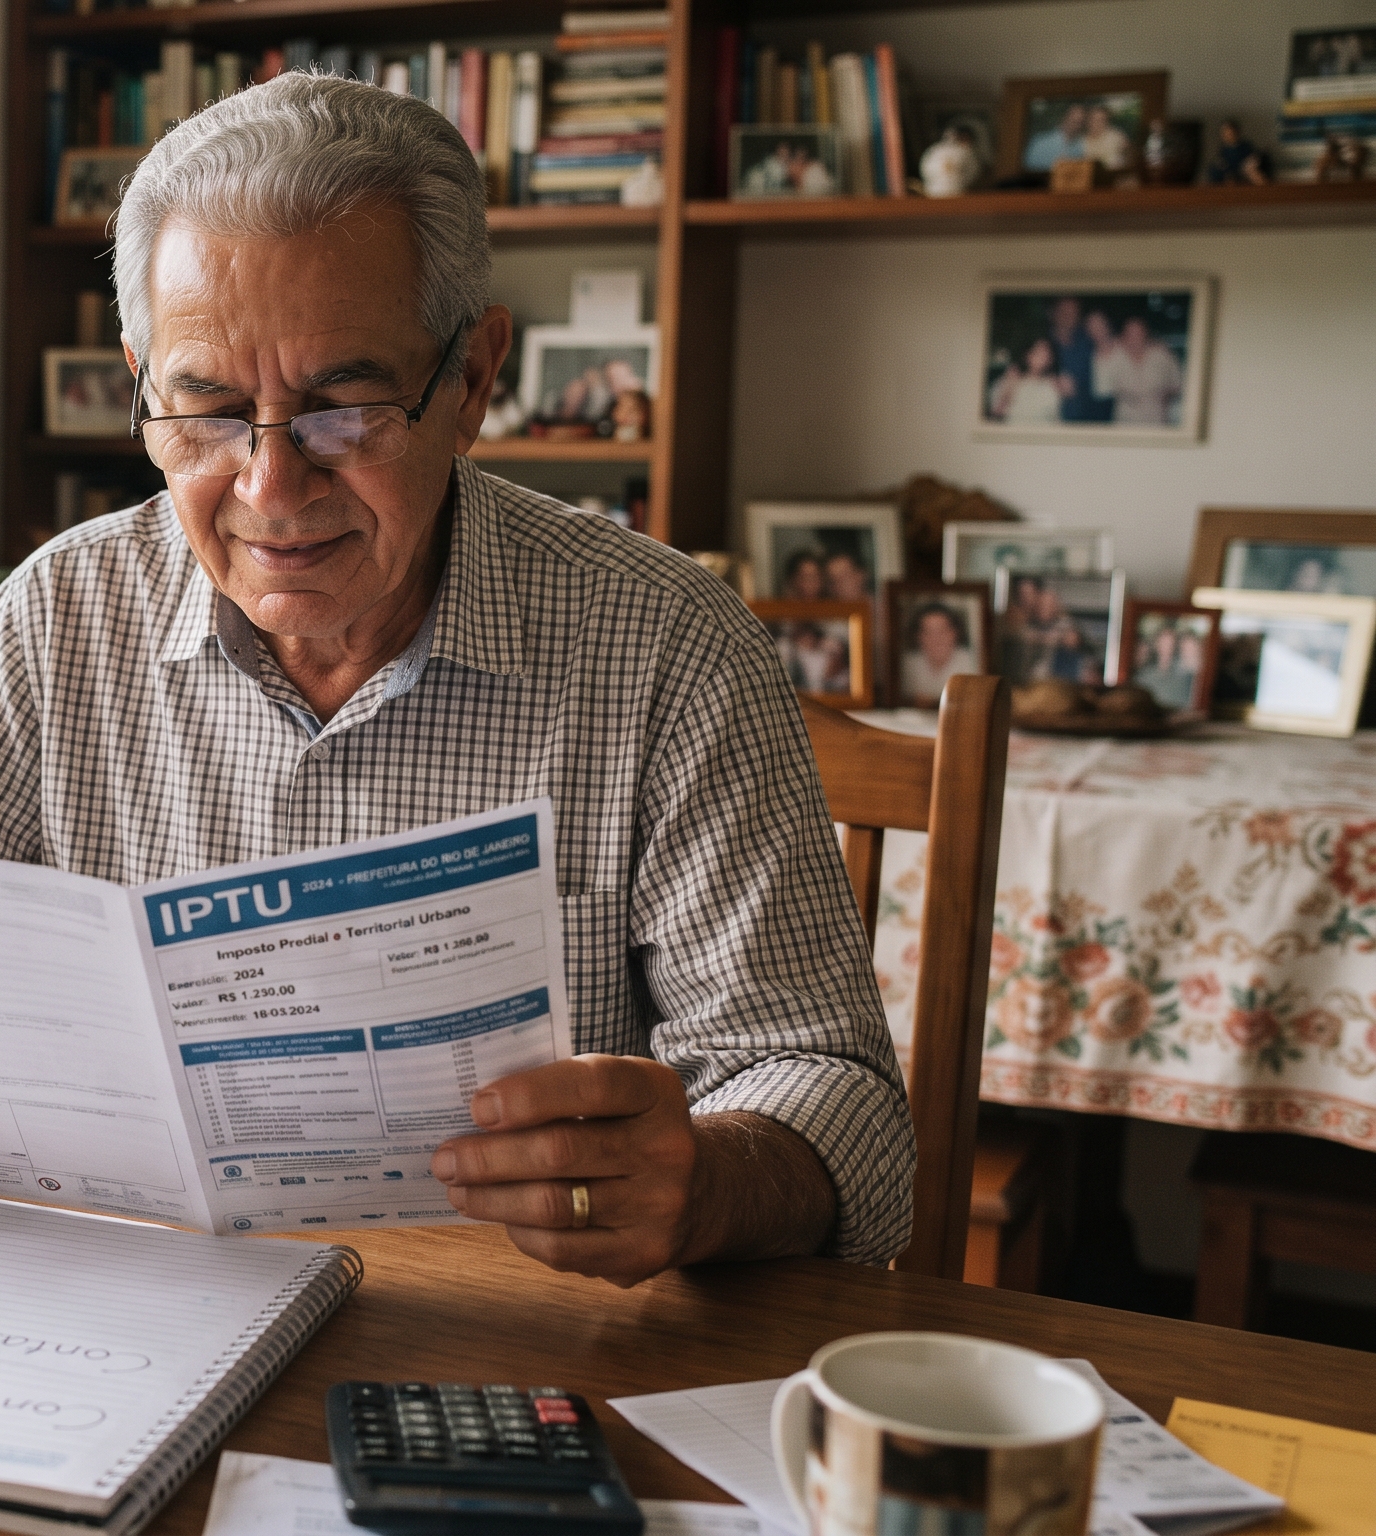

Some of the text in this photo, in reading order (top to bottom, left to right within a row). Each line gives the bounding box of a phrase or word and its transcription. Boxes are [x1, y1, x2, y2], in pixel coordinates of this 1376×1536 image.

[346, 860, 419, 885] PREFEITURA
[420, 856, 439, 871] DO
[440, 850, 462, 865] RIO
[463, 847, 480, 860] DE
[159, 878, 293, 937] IPTU
[216, 905, 471, 961] Imposto Predial e Territorial Urbano
[233, 967, 265, 982] 2024
